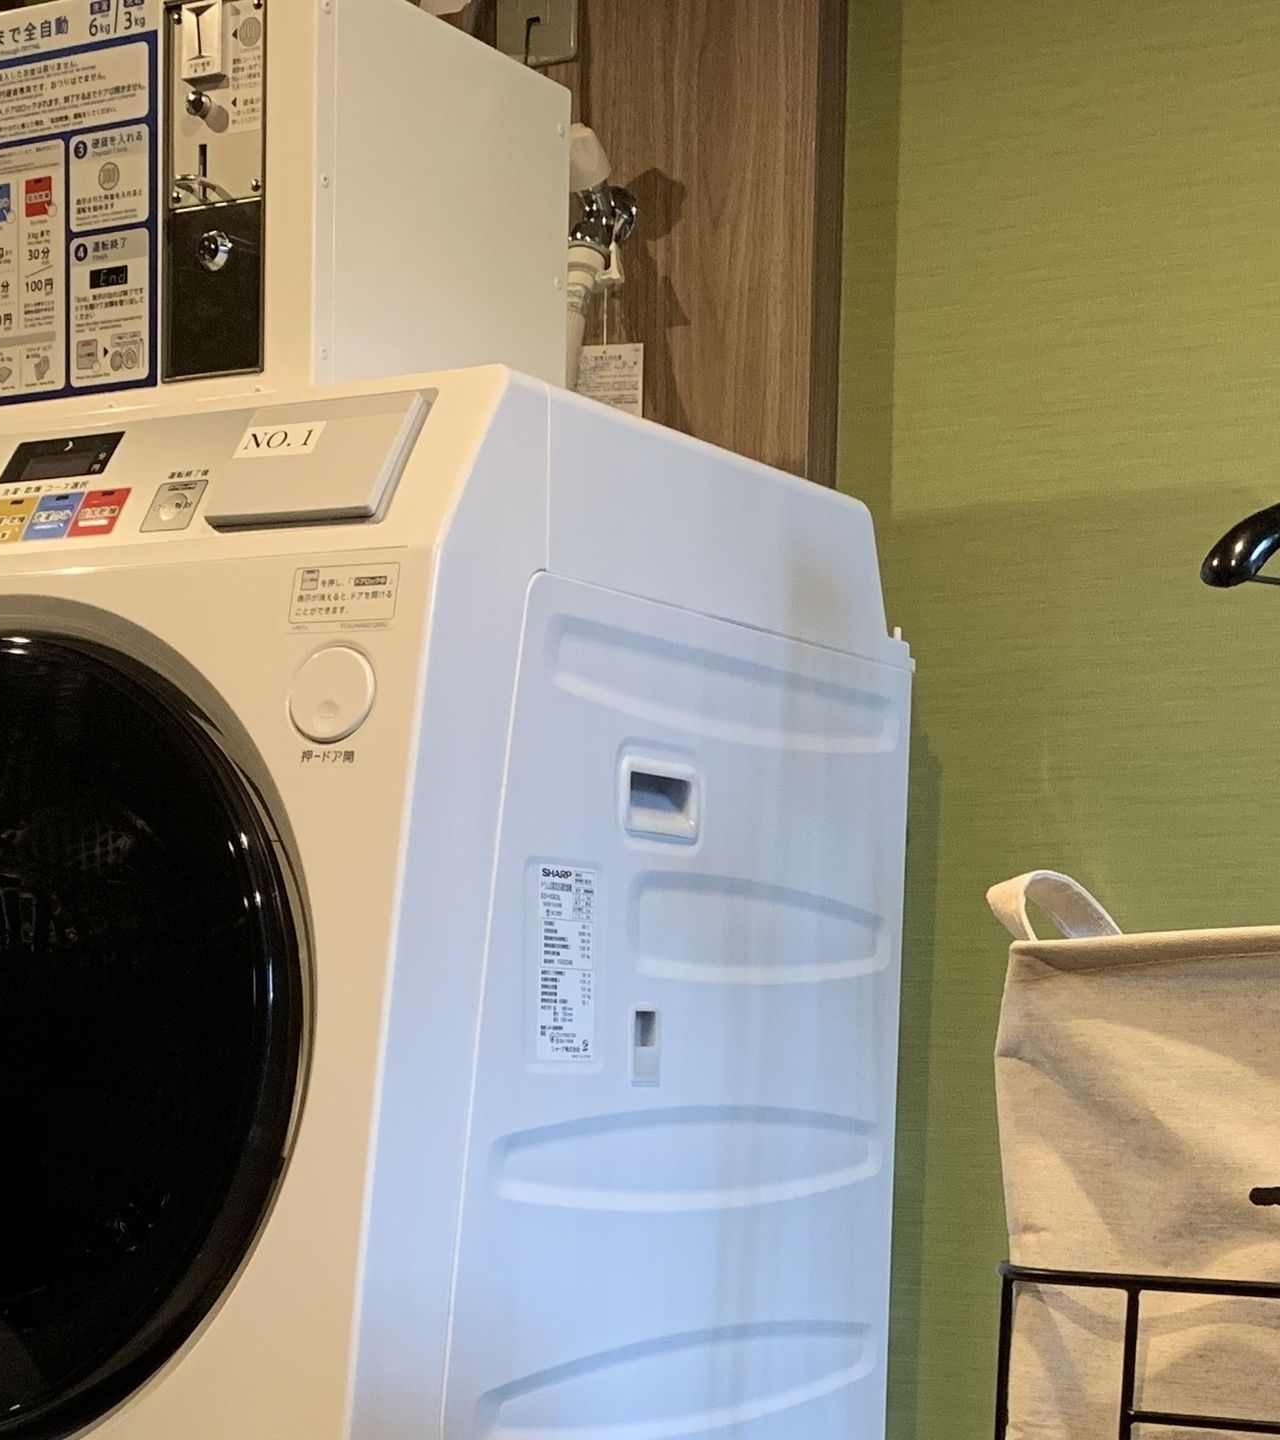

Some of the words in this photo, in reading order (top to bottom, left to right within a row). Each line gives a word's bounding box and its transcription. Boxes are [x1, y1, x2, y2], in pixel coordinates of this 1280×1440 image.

[89, 18, 111, 37] 6kg
[123, 11, 146, 31] 3kg
[91, 131, 143, 149] 硬貨を入れる
[92, 237, 127, 253] 運転終了
[27, 248, 50, 261] 30分
[25, 278, 54, 292] 100円
[99, 270, 127, 286] End
[542, 868, 572, 880] SHARP
